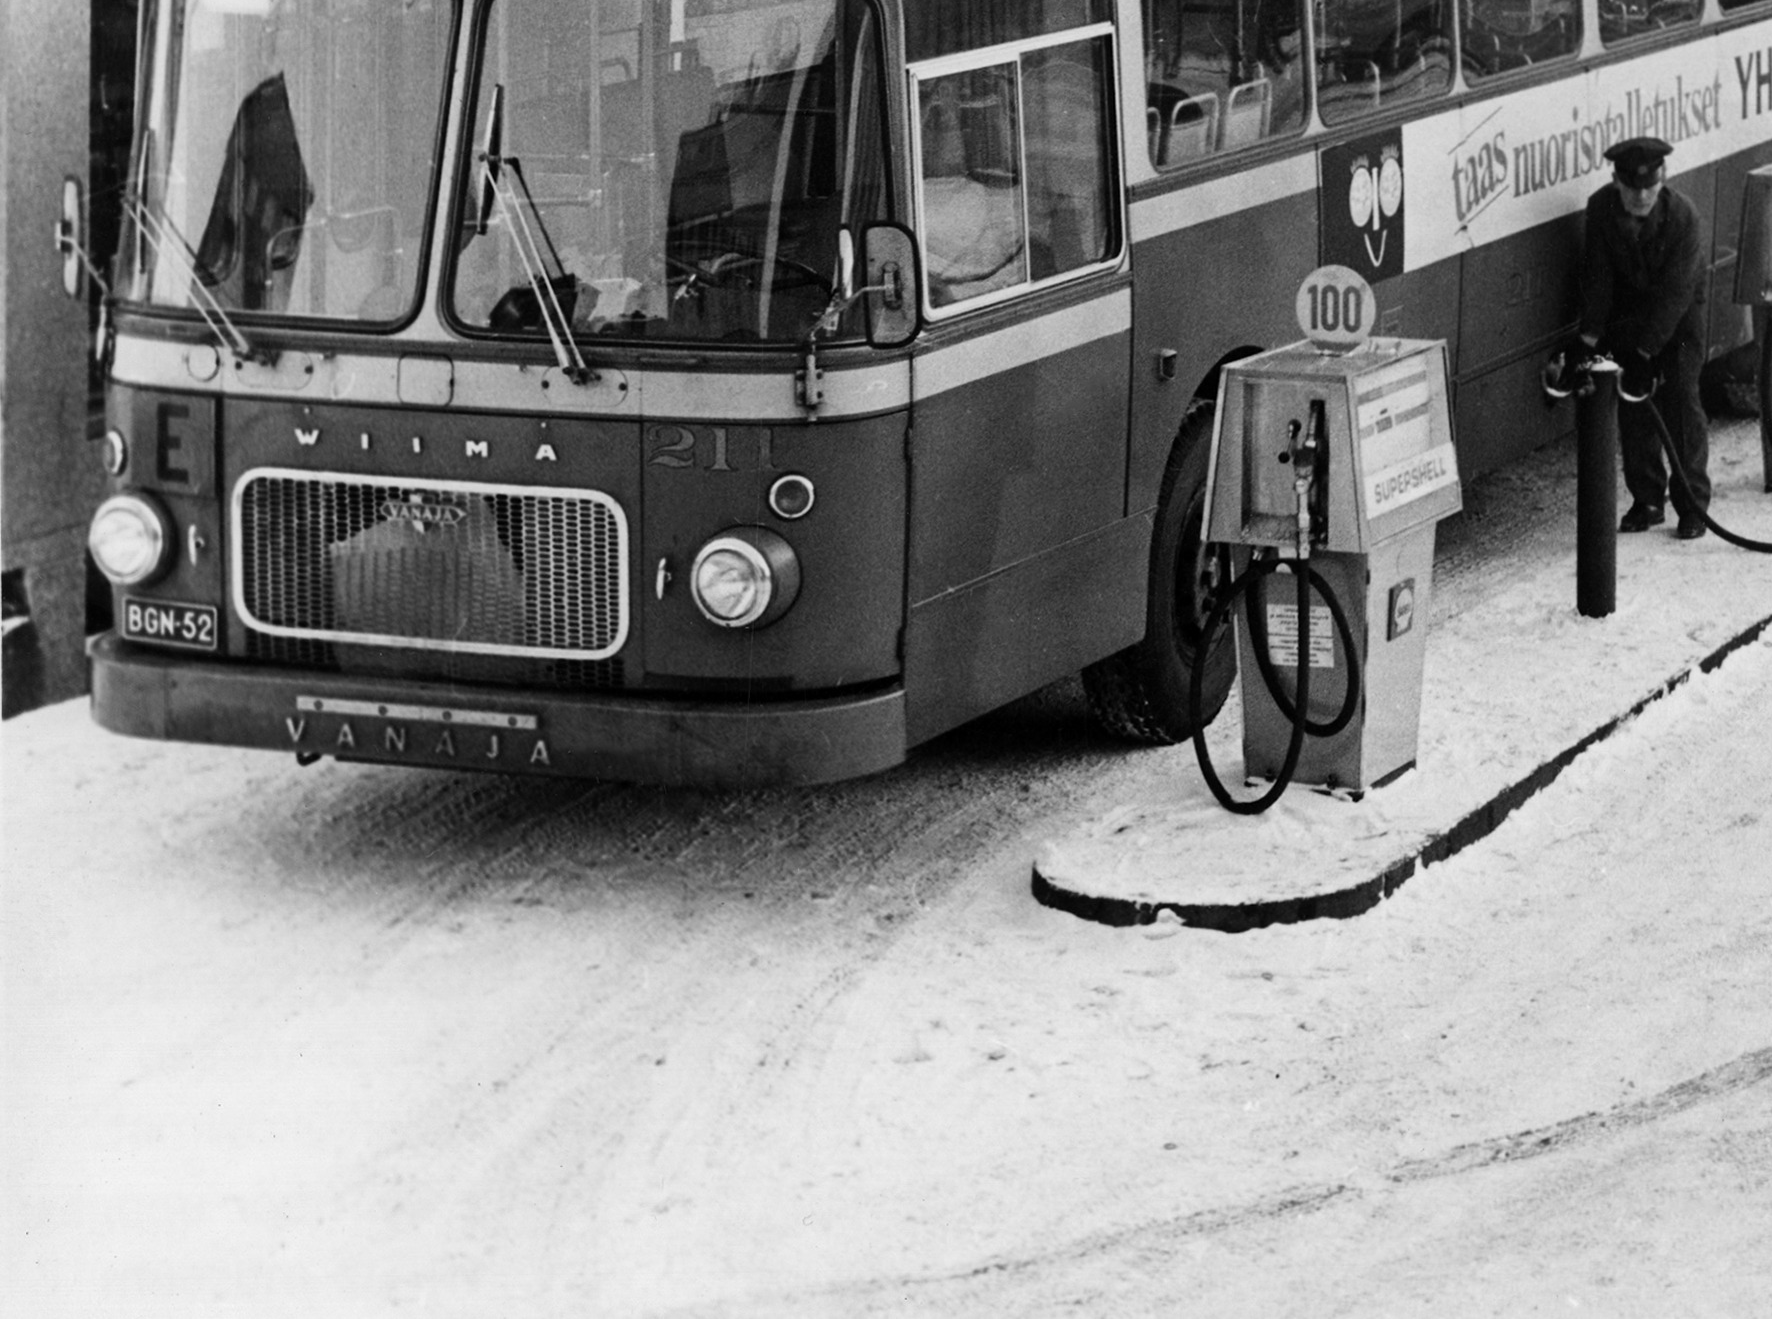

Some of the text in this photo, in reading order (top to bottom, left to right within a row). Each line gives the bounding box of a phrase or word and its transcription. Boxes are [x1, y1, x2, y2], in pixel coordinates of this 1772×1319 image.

[1451, 130, 1508, 222] taas
[1512, 69, 1723, 198] nuorisotalletukset
[1306, 283, 1362, 334] 100
[157, 402, 190, 483] E
[294, 428, 558, 461] WIIMA
[1373, 457, 1448, 504] SUPERSHELL
[388, 502, 454, 523] VANAJA
[127, 604, 213, 642] BGN-52
[285, 715, 551, 766] VANAJA
